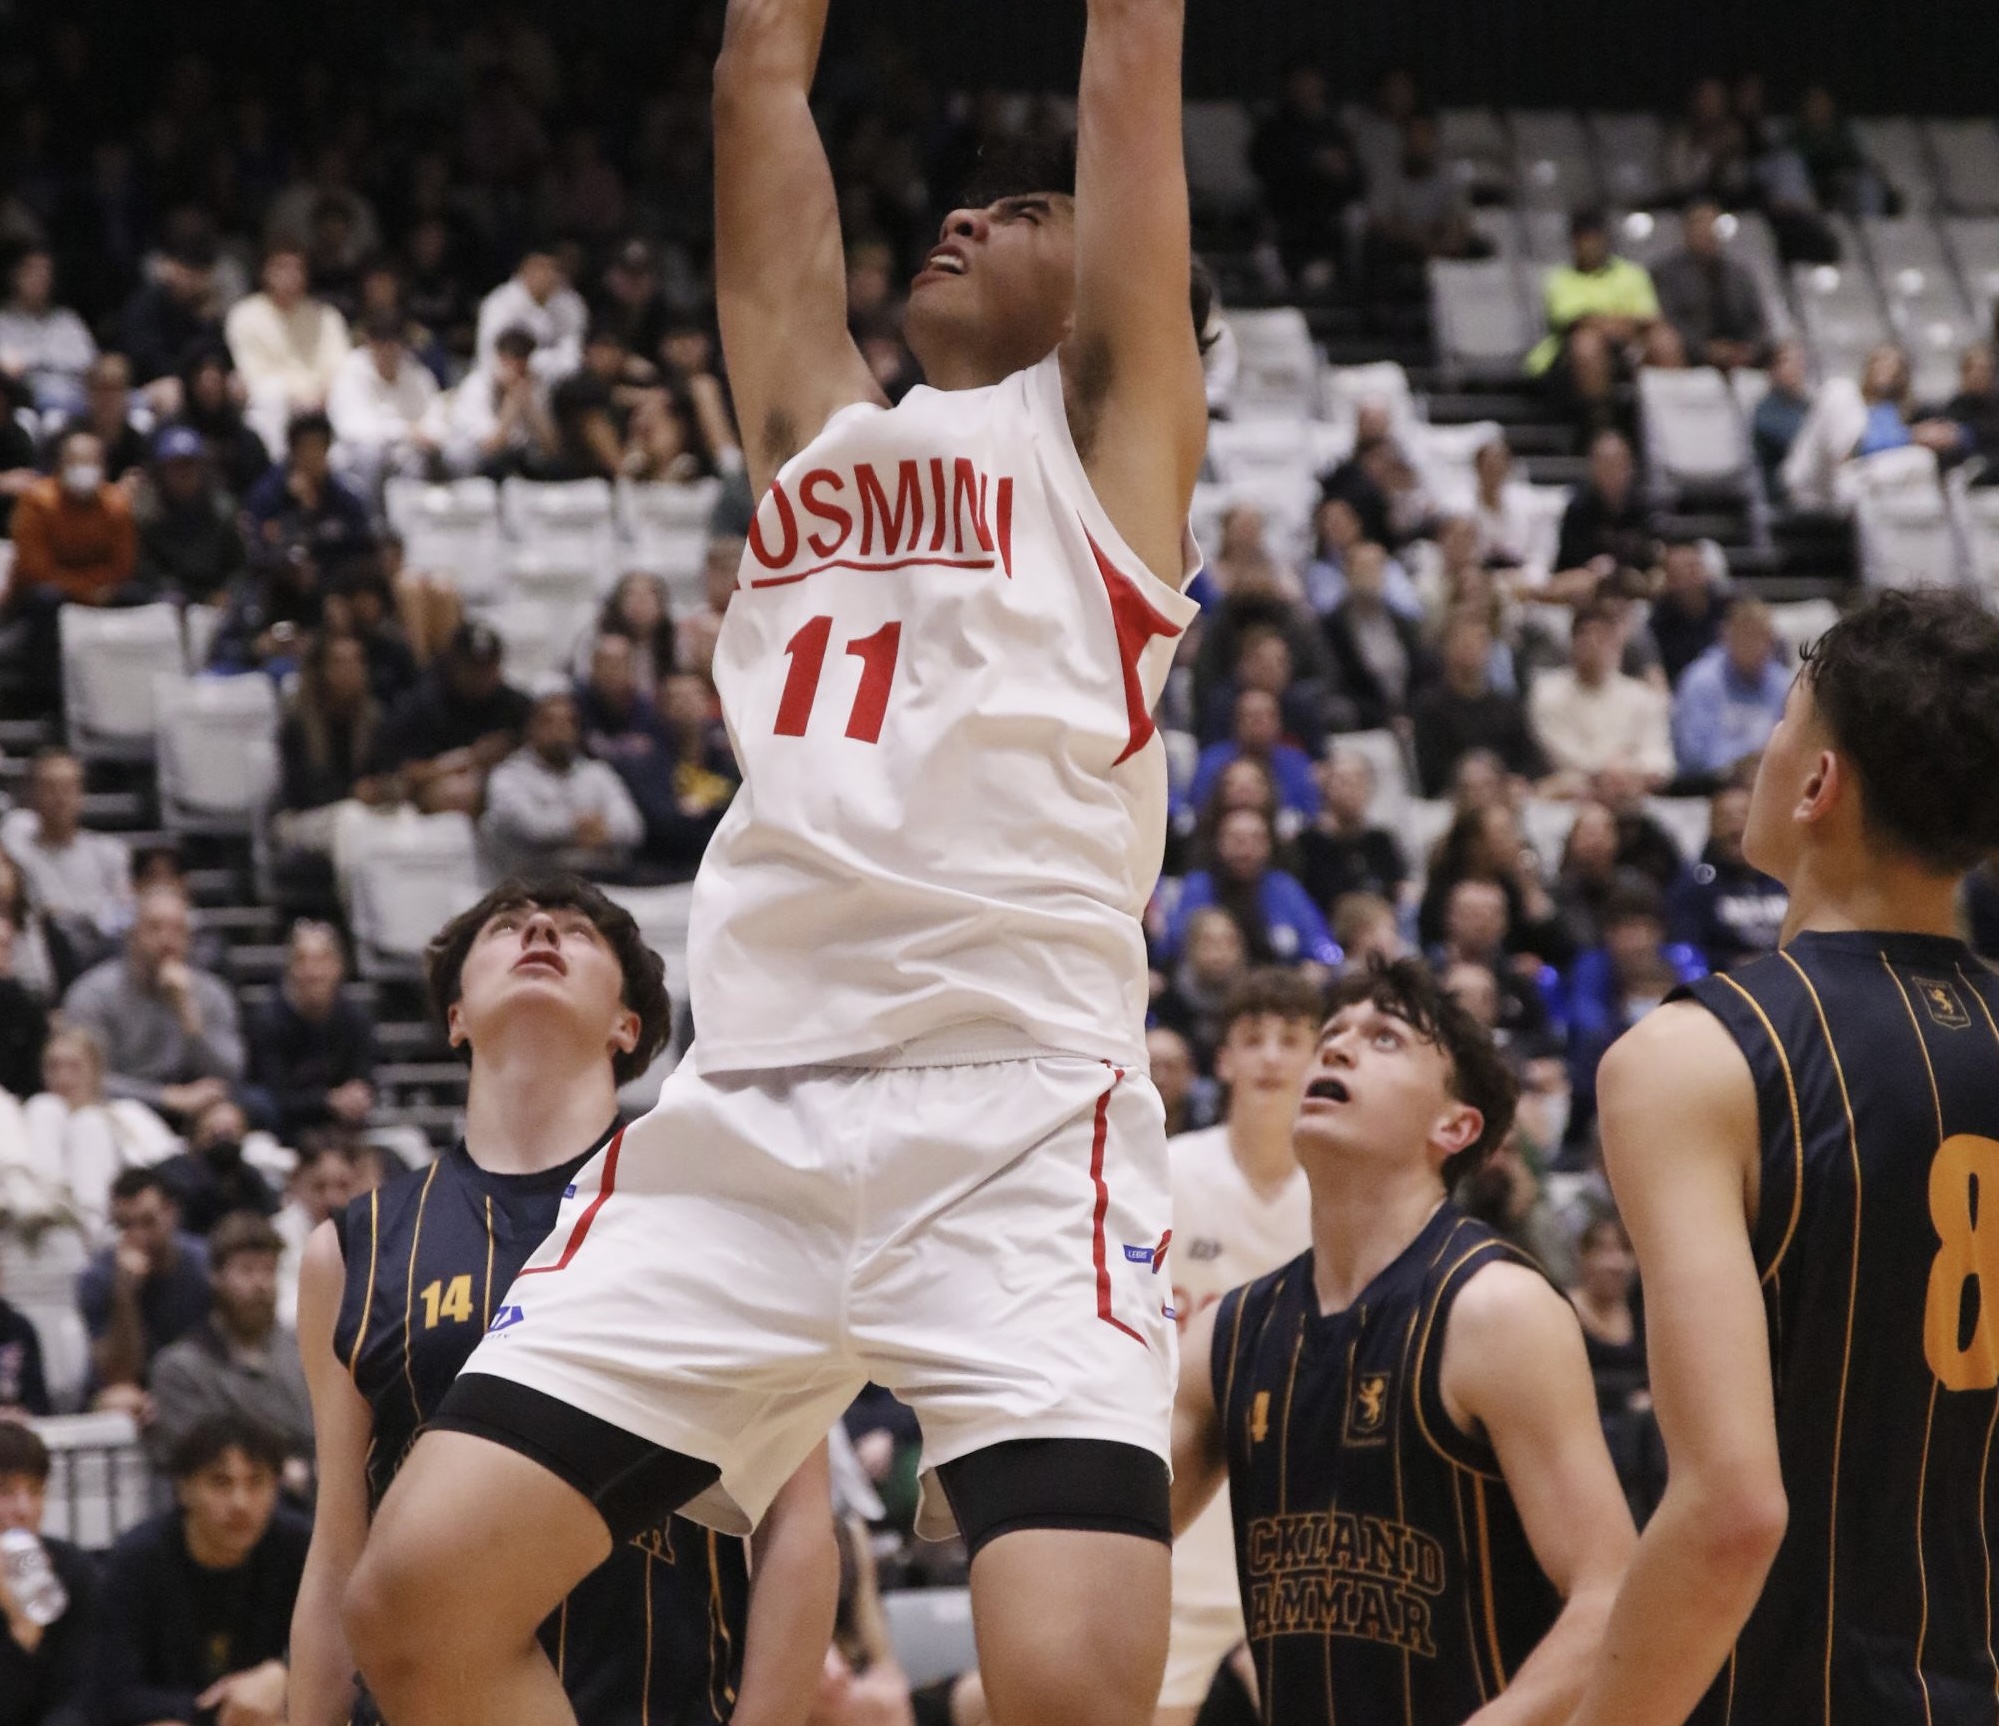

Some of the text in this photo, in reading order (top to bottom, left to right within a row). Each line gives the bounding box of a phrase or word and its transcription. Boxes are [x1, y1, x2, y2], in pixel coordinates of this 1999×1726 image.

[773, 615, 902, 744] 11
[420, 1273, 474, 1330] 14
[1924, 1133, 1999, 1391] 8
